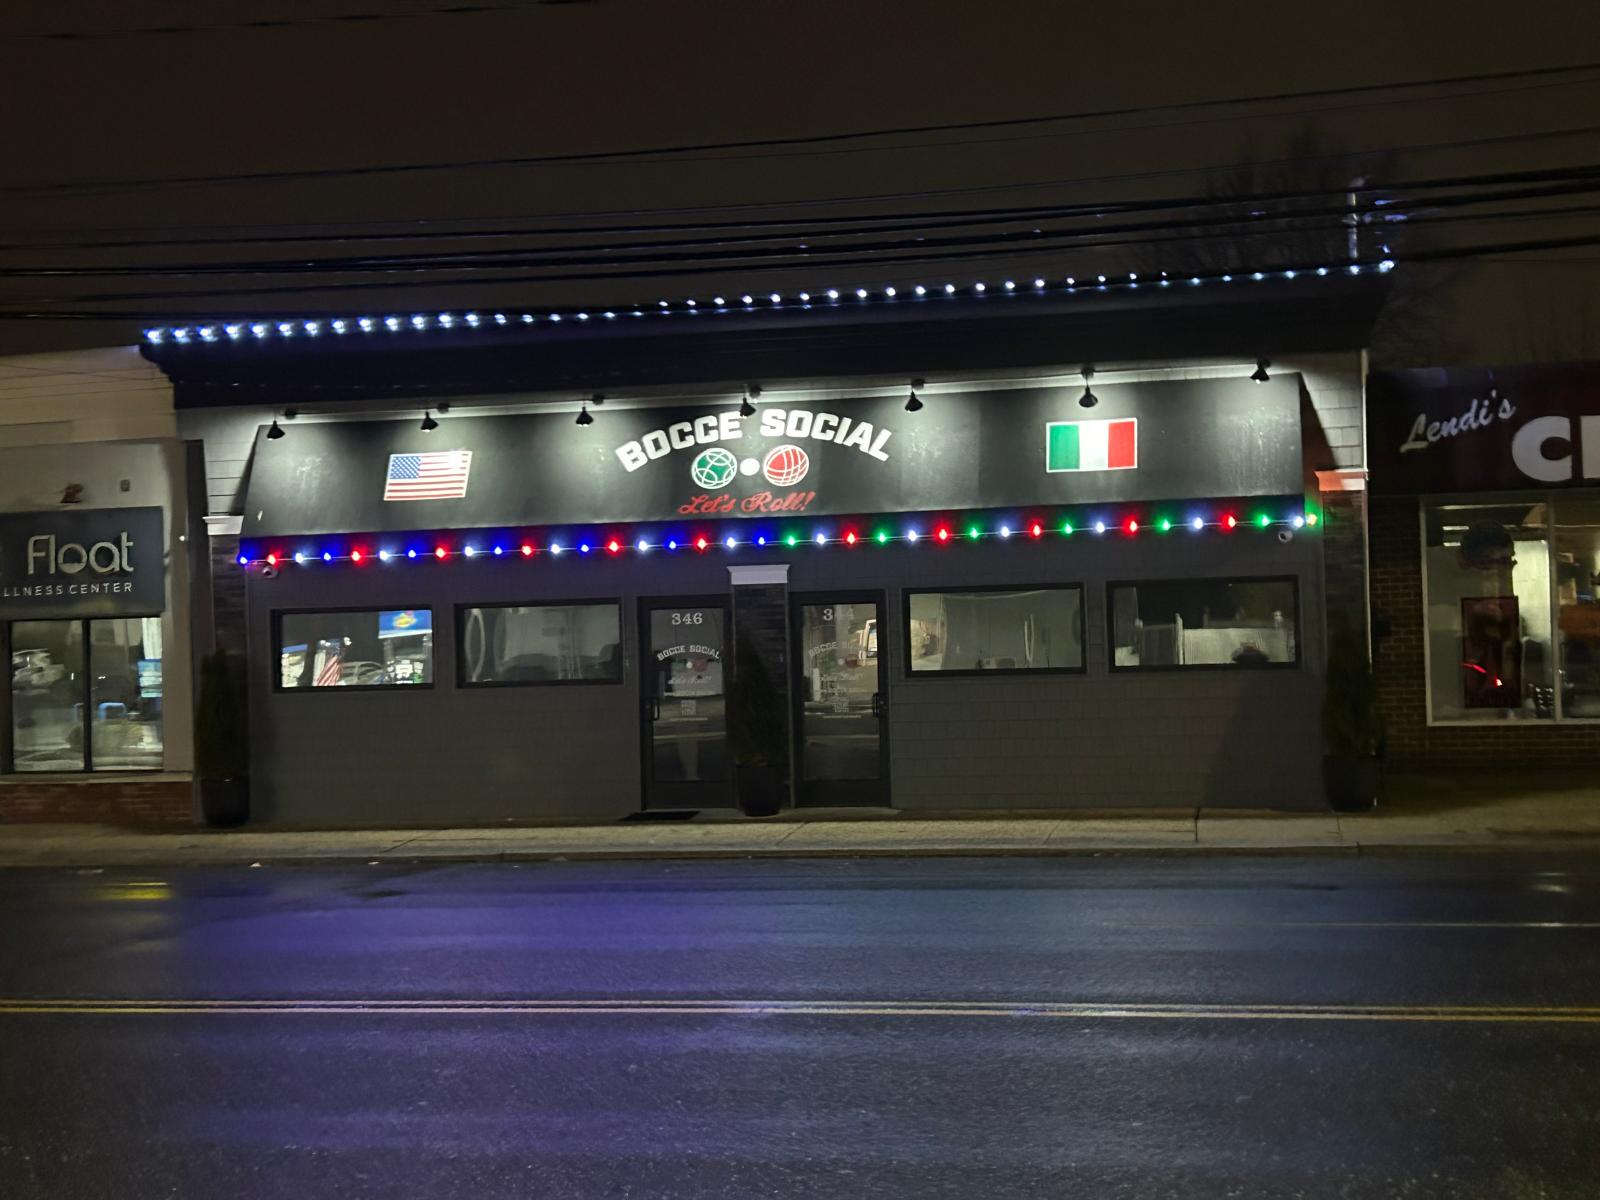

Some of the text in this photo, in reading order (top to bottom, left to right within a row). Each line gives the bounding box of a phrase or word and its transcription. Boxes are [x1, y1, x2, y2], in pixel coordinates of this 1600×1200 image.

[1400, 389, 1516, 453] Lendi's
[615, 408, 892, 473] BOCCE SOCIAL
[679, 490, 817, 515] Let's Roll!
[69, 581, 133, 595] CENTER
[671, 612, 704, 626] 346
[657, 644, 720, 662] BOCCE SOCIAL
